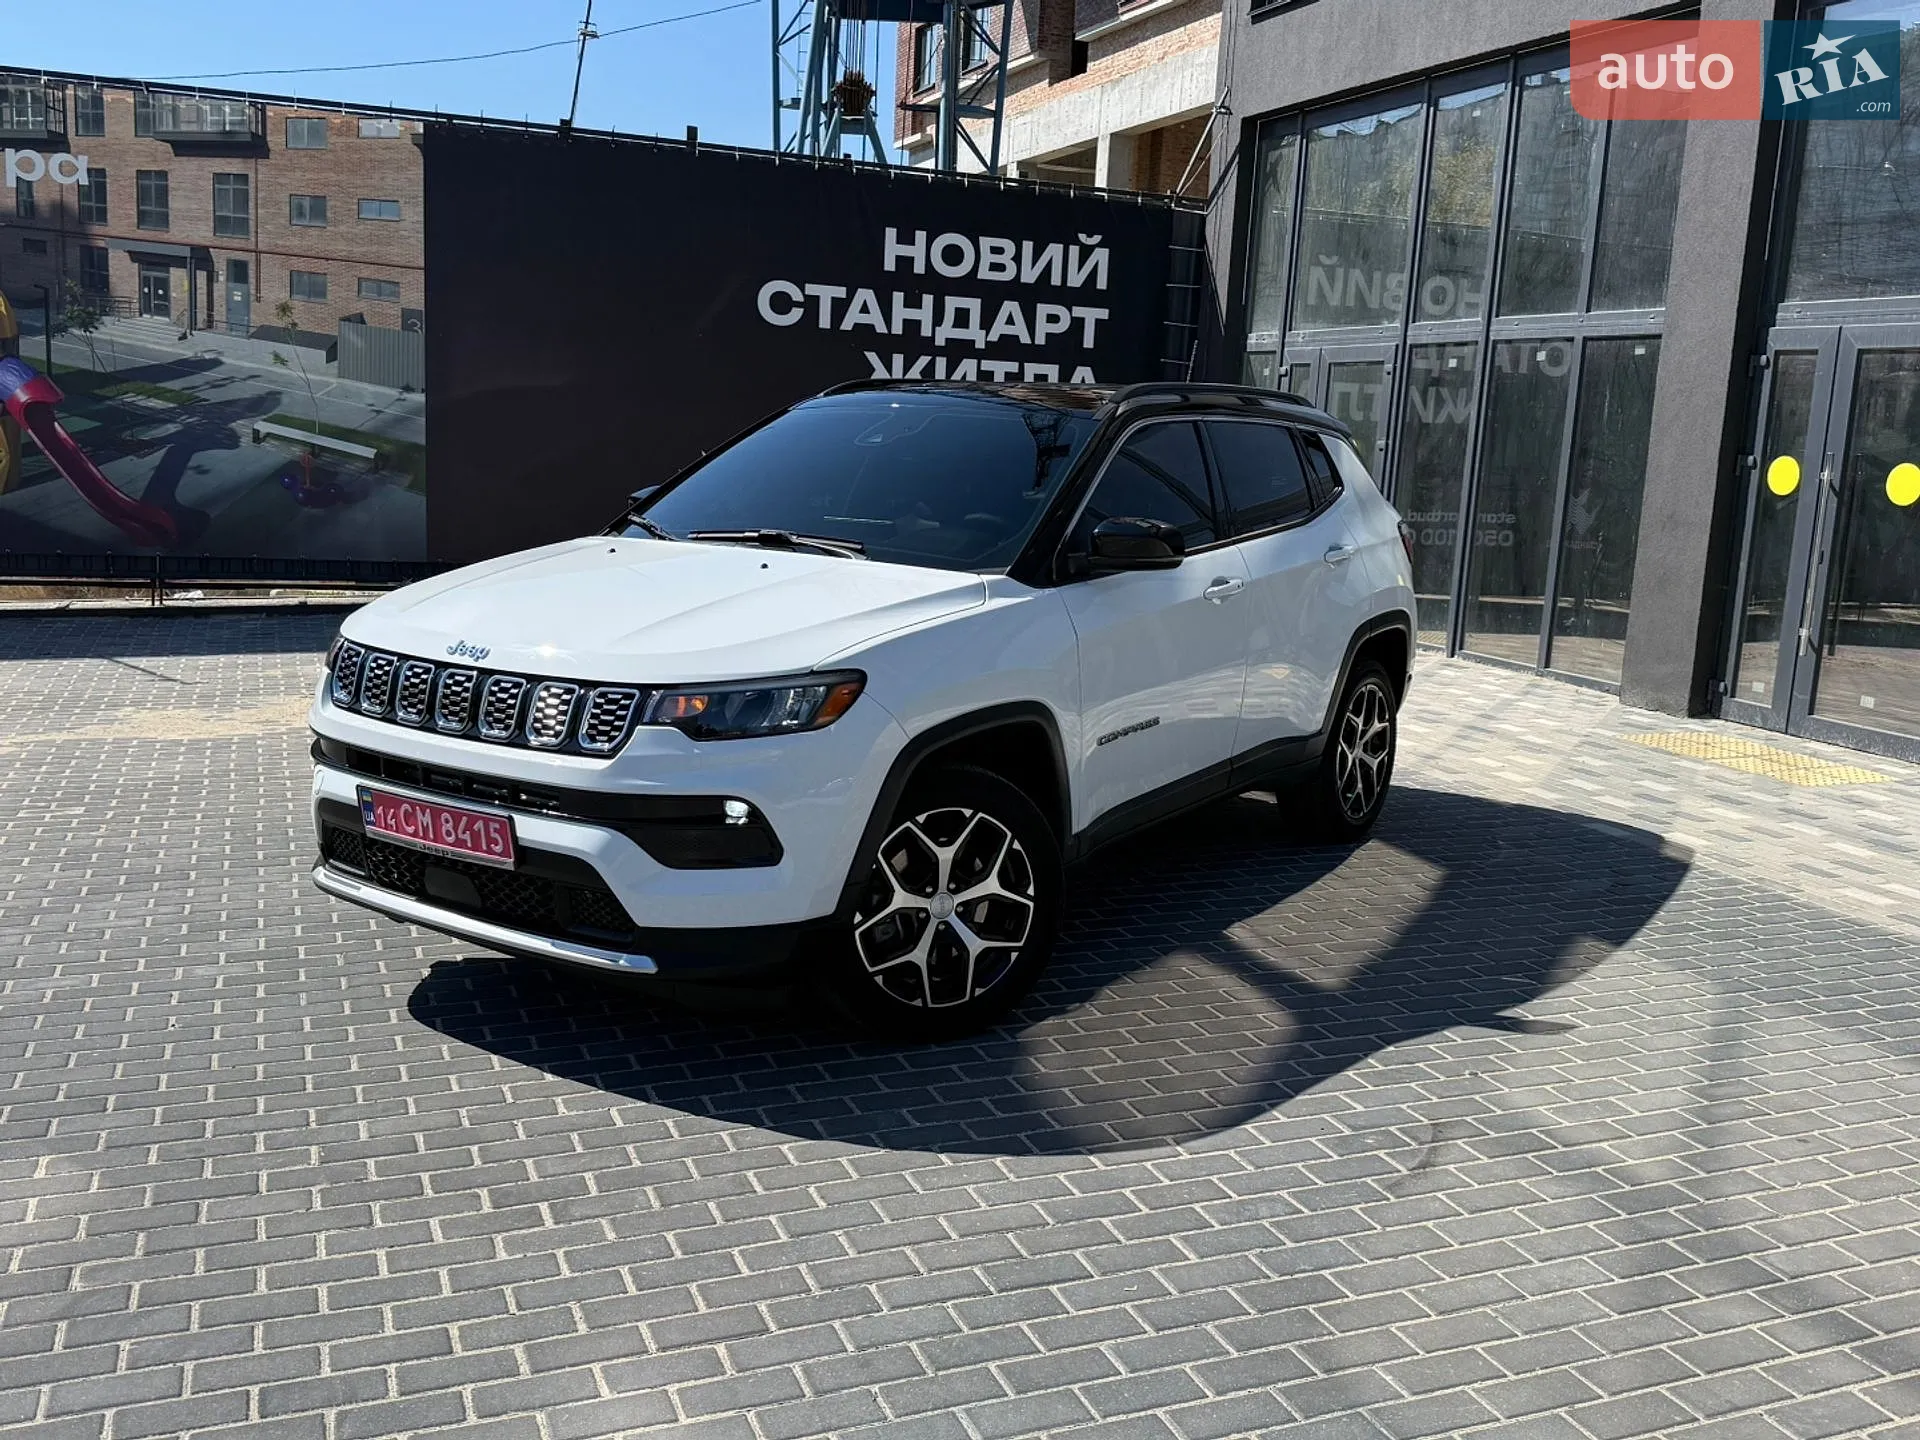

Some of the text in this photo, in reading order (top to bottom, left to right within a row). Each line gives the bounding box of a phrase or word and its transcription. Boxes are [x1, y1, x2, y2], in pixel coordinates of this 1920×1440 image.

[1, 148, 89, 188] ра
[883, 226, 1110, 290] НОВИЙ
[757, 279, 1110, 349] СТАНДАРТ
[446, 640, 491, 662] Jeep
[1096, 716, 1160, 746] COMPASS
[365, 811, 376, 824] UA
[440, 811, 504, 853] 8415
